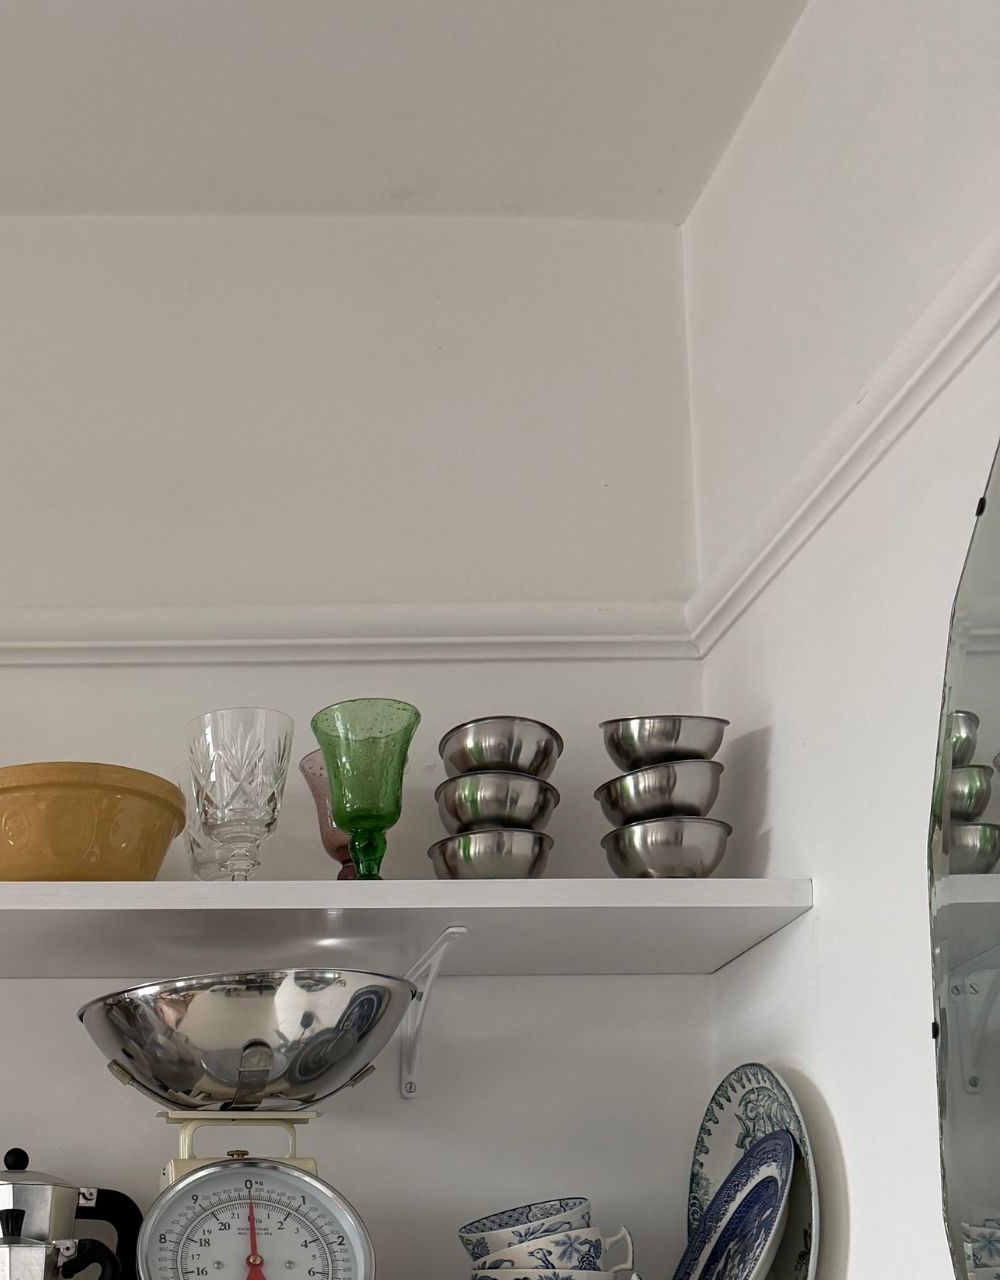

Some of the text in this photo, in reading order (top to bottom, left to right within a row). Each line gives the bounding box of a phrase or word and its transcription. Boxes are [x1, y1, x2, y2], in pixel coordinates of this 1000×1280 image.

[245, 1180, 252, 1189] 0
[192, 1195, 198, 1204] 9
[301, 1196, 305, 1205] 1
[218, 1222, 230, 1230] 20
[277, 1222, 284, 1230] 2
[159, 1234, 166, 1243] 8
[200, 1239, 210, 1247] 18
[337, 1236, 345, 1245] 2
[301, 1240, 308, 1248] 4
[197, 1267, 208, 1276] 16
[308, 1268, 315, 1276] 6
